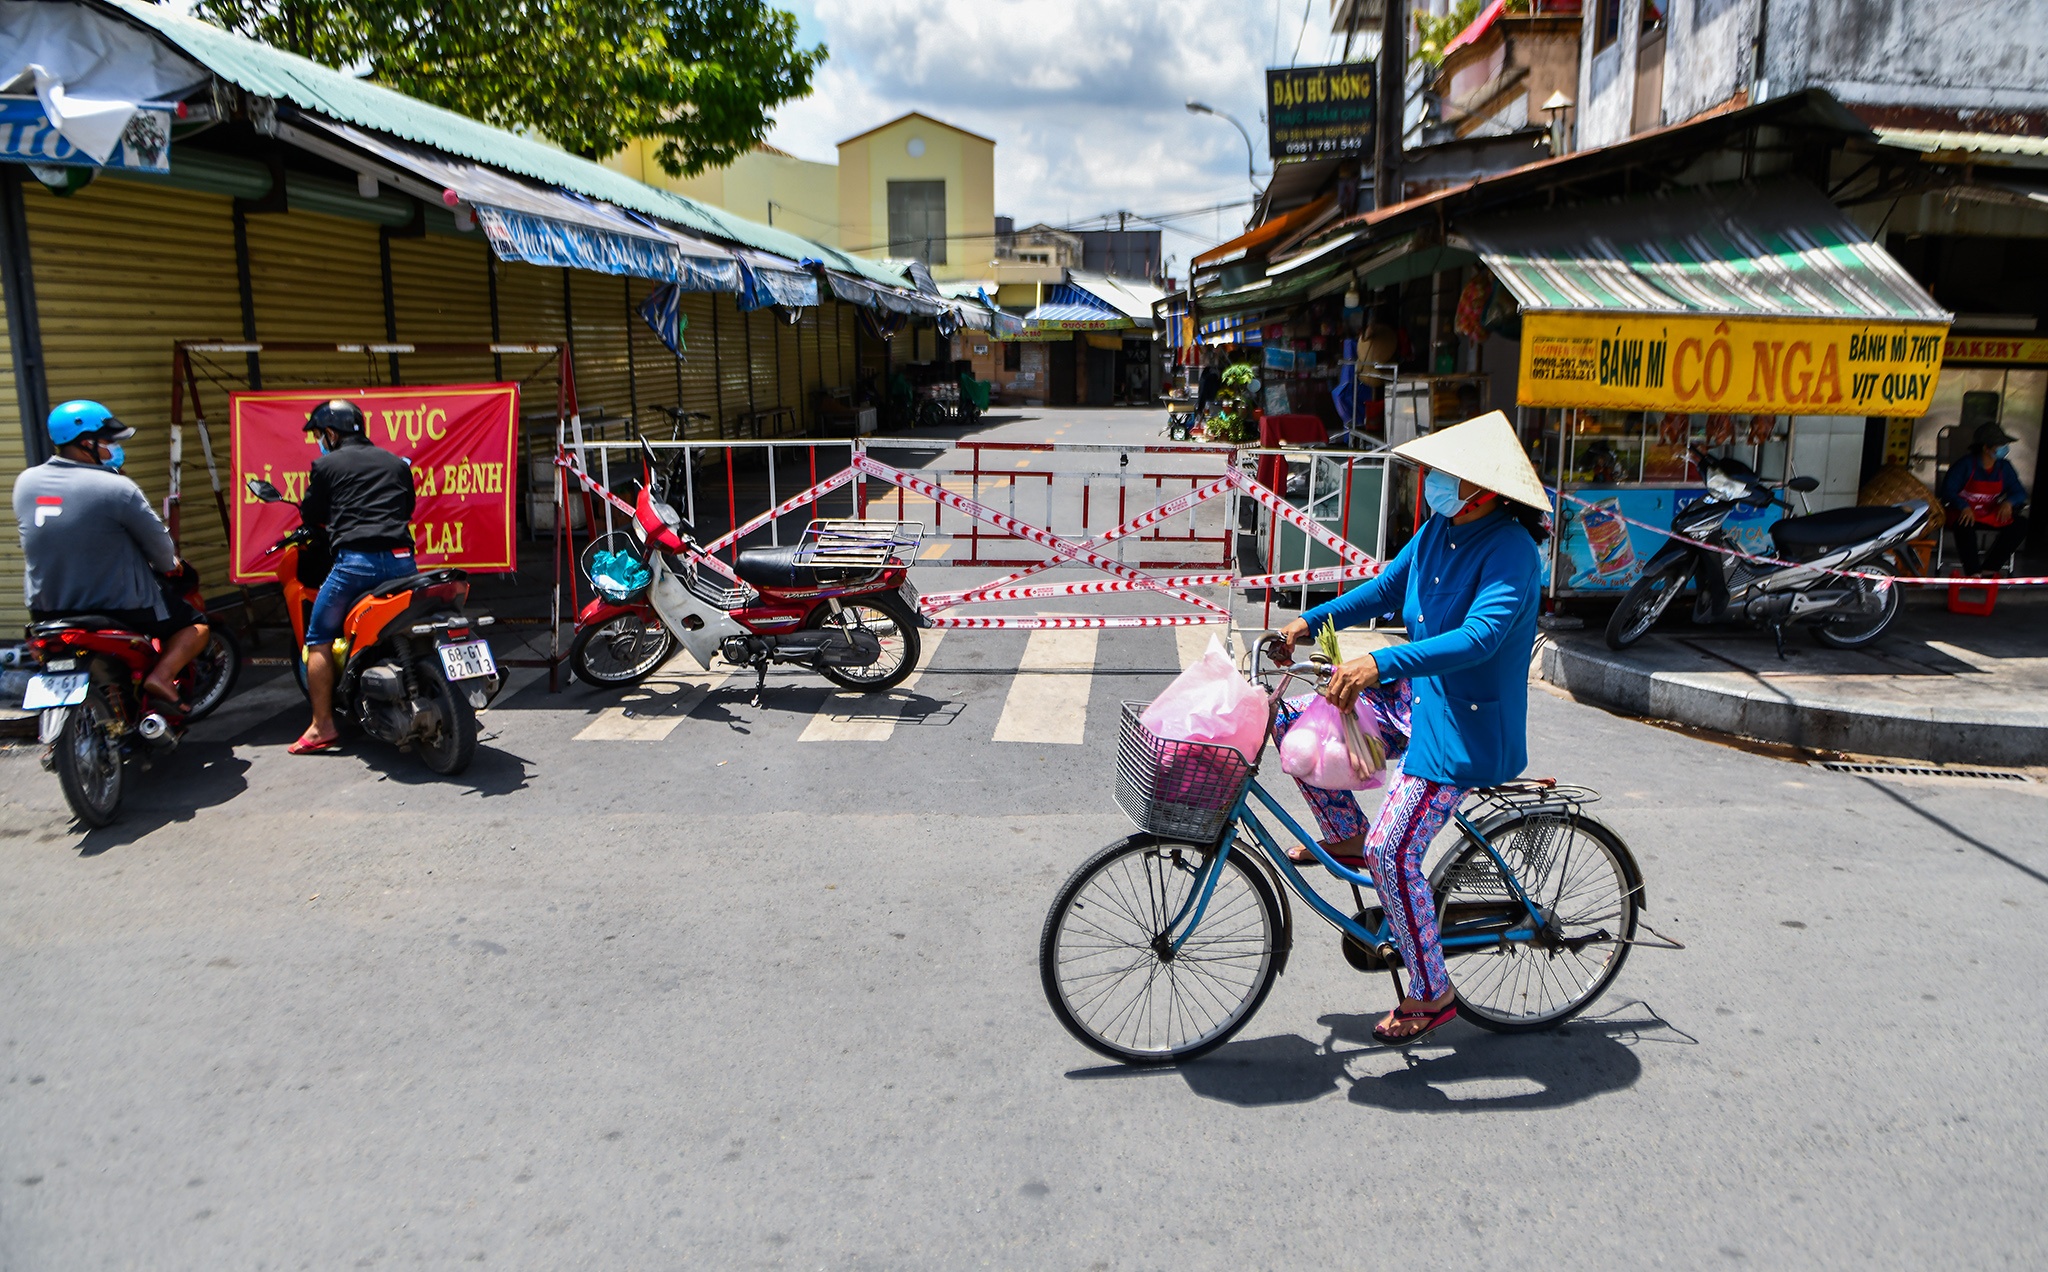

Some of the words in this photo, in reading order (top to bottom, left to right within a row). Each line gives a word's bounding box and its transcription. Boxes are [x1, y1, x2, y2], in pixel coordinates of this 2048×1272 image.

[1286, 142, 1313, 154] 0981
[1317, 140, 1336, 152] 781
[1341, 138, 1362, 150] 543
[1600, 326, 1643, 387] BÁNH
[1646, 328, 1668, 388] MÌ
[1672, 320, 1732, 402] CÔ
[1747, 340, 1843, 404] NGA
[1849, 326, 1888, 362] BÁNH
[1890, 328, 1907, 362] MÌ
[1910, 335, 1941, 369] THỊT
[1944, 341, 2023, 358] BAKERY
[1852, 373, 1880, 406] VỊT
[1882, 373, 1931, 404] QUAY
[382, 403, 447, 449] VỰC
[442, 455, 503, 502] BỆNH
[425, 521, 464, 561] LẠI
[447, 644, 483, 662] 68-G1
[447, 658, 492, 678] 820.13
